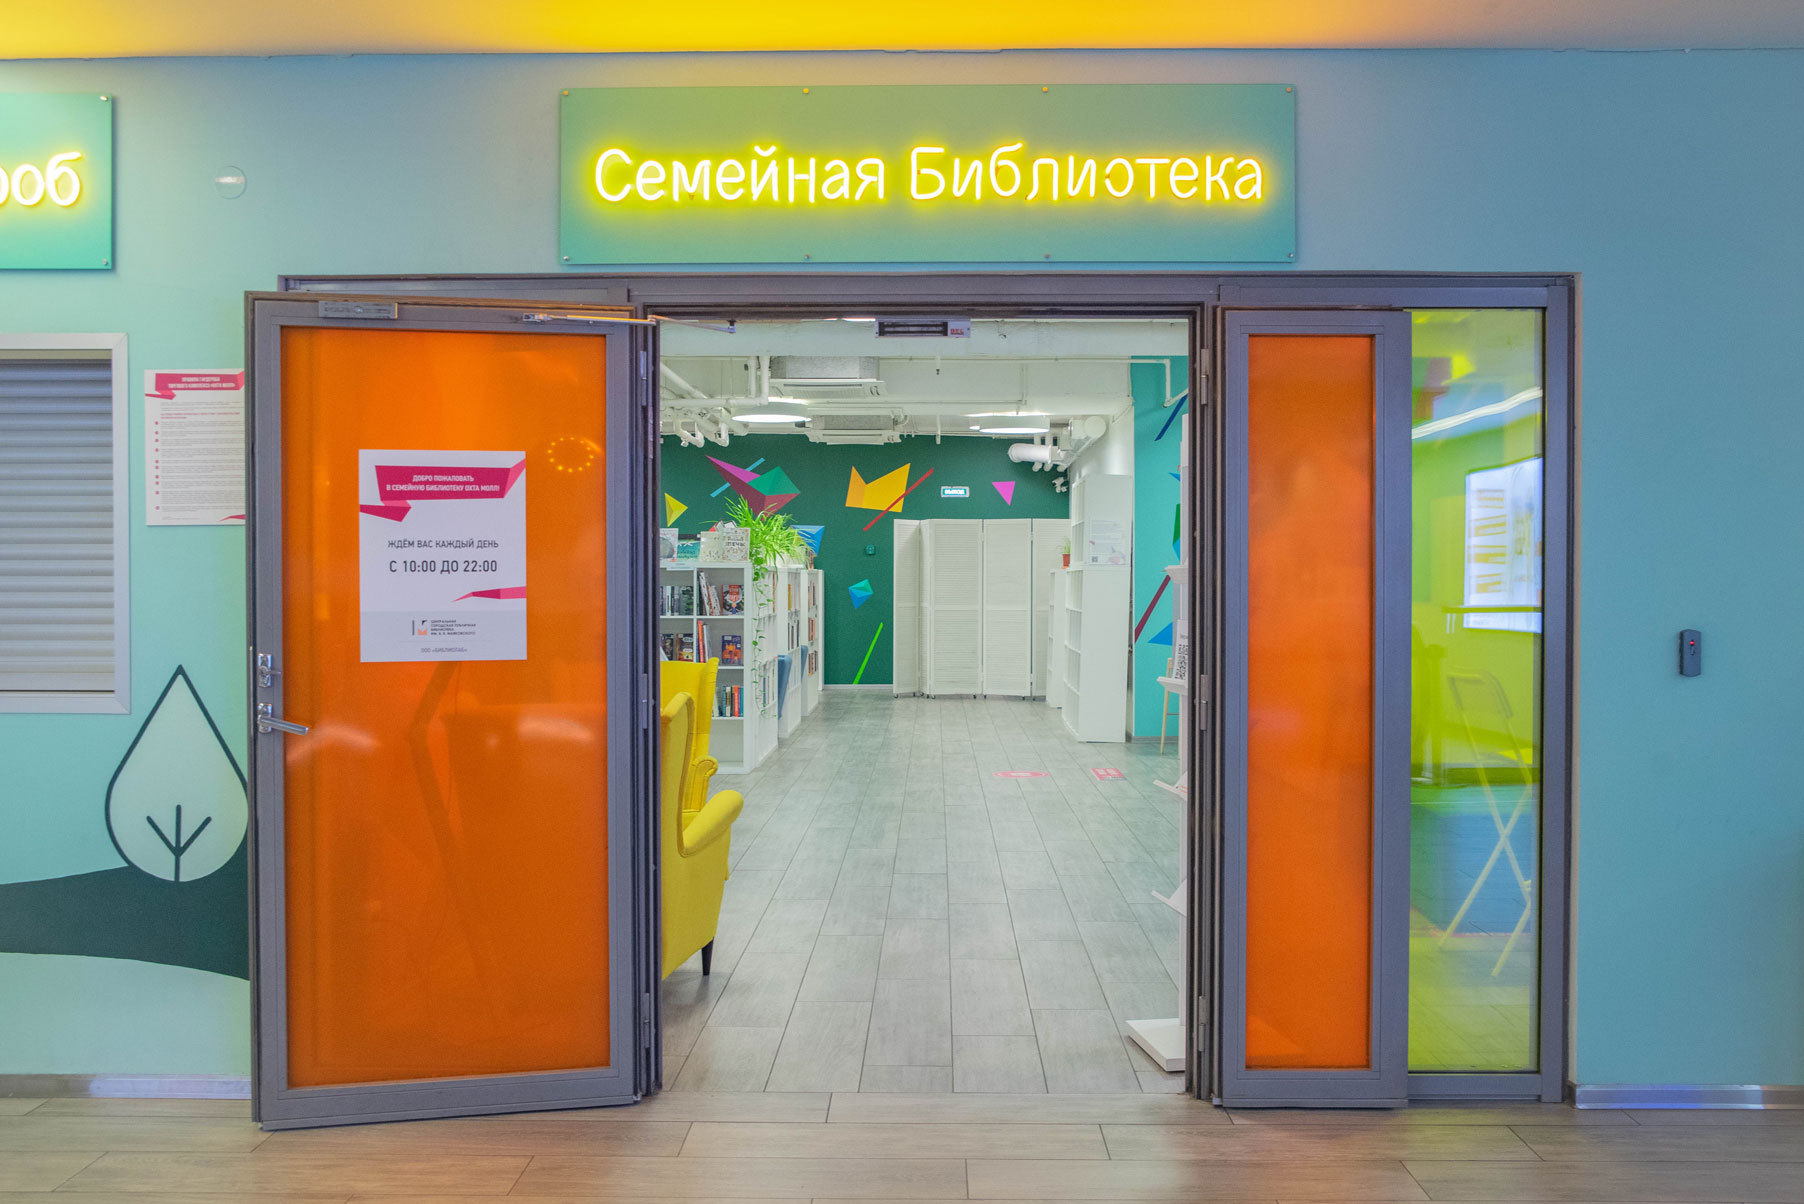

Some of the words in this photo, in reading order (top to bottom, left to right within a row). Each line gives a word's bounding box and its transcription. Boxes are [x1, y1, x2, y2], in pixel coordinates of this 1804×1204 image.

[595, 144, 886, 203] Семейная
[909, 141, 1264, 202] Библиотека
[412, 474, 433, 482] ДОБРО
[391, 483, 425, 491] СЕМЕЙНУЮ
[387, 538, 415, 549] ЖДЁМ
[416, 539, 433, 549] ВАС
[435, 538, 475, 549] КАЖДЫЙ
[476, 539, 499, 550] ДЕНЬ
[389, 560, 397, 573] С
[402, 560, 437, 573] 10:00
[440, 560, 459, 574] ДО
[463, 560, 498, 573] 22:00
